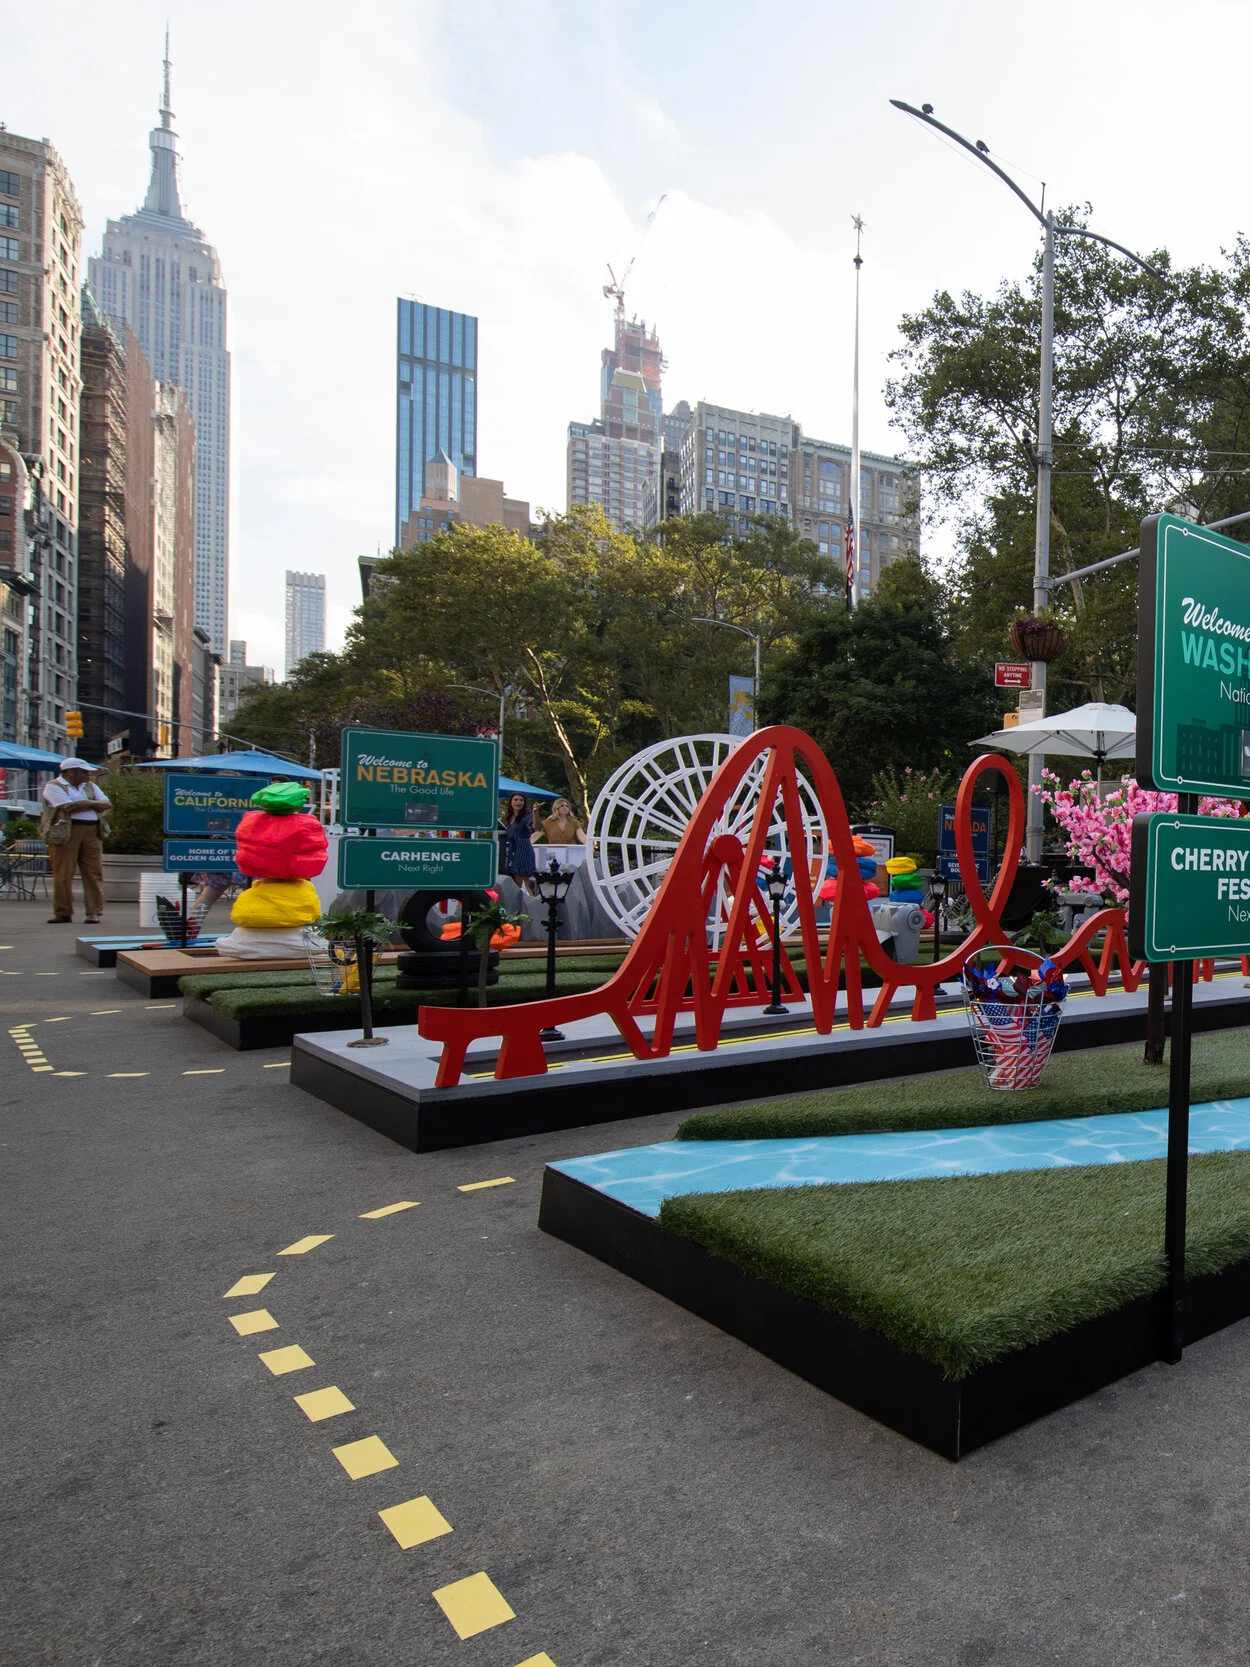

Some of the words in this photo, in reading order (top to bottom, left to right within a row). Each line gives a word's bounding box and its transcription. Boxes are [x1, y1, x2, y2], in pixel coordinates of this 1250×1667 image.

[357, 754, 412, 768] Welcome
[416, 759, 428, 769] to
[357, 765, 488, 788] NEBRASKA
[174, 788, 212, 797] Welcome
[389, 784, 406, 793] The
[409, 785, 437, 795] Good
[440, 786, 454, 796] Life
[380, 851, 461, 862] CARHENGE
[1170, 846, 1250, 872] CHERRY
[398, 864, 420, 872] Next
[422, 864, 444, 874] Right
